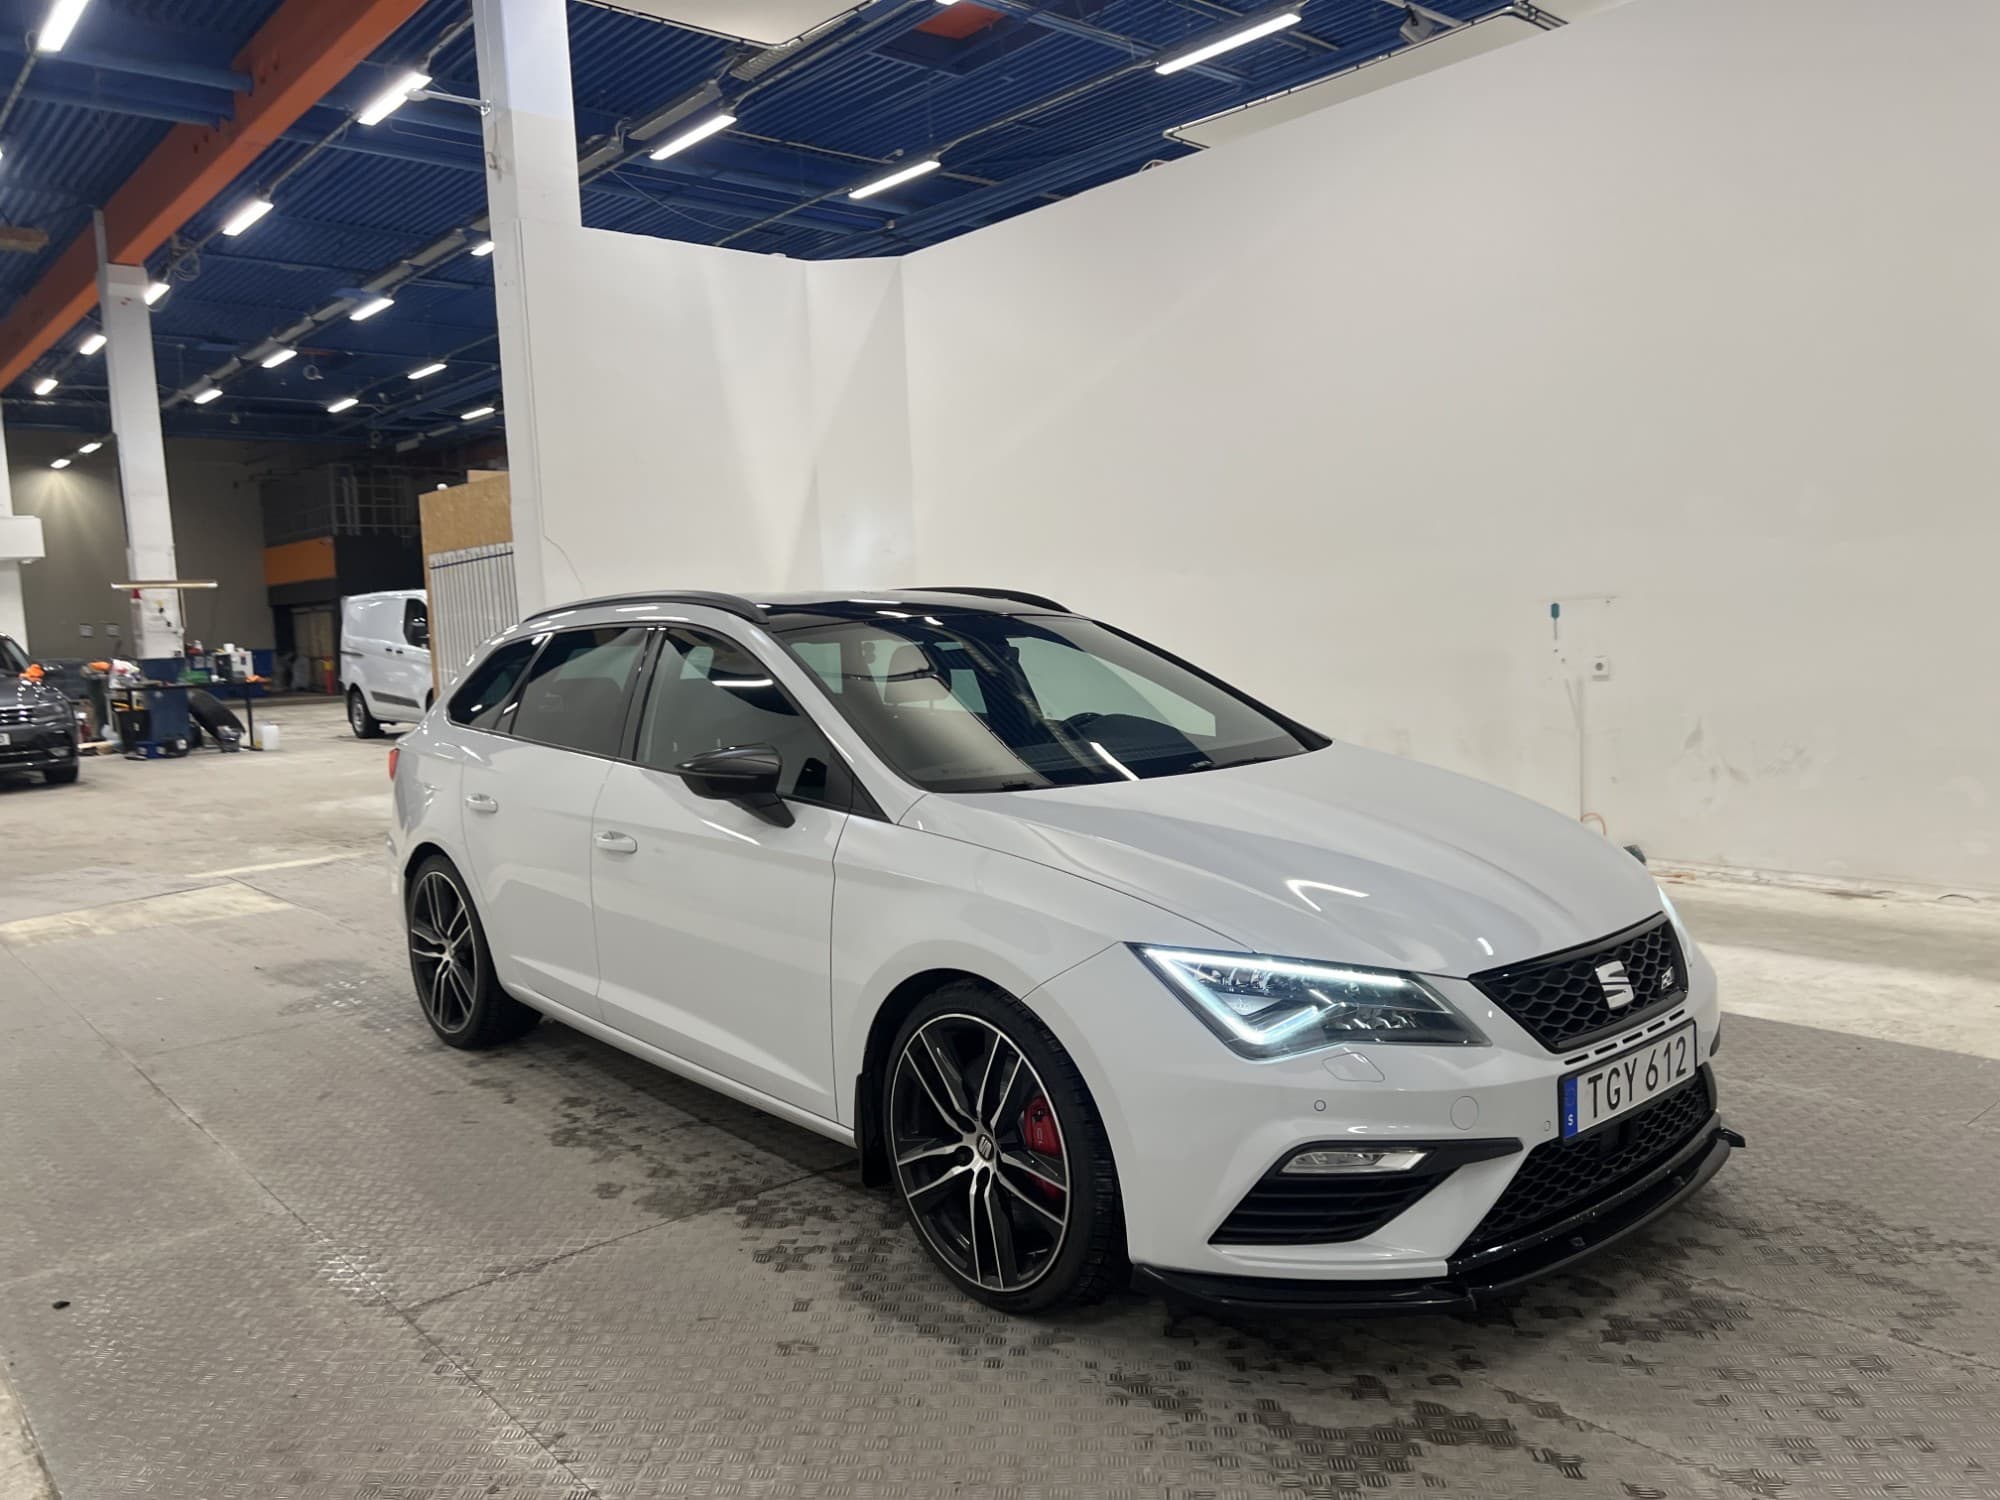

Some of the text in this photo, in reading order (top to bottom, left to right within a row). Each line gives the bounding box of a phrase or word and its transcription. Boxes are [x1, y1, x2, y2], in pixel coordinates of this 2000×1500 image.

[1587, 1036, 1687, 1119] TGY 612
[1567, 1114, 1574, 1126] S
